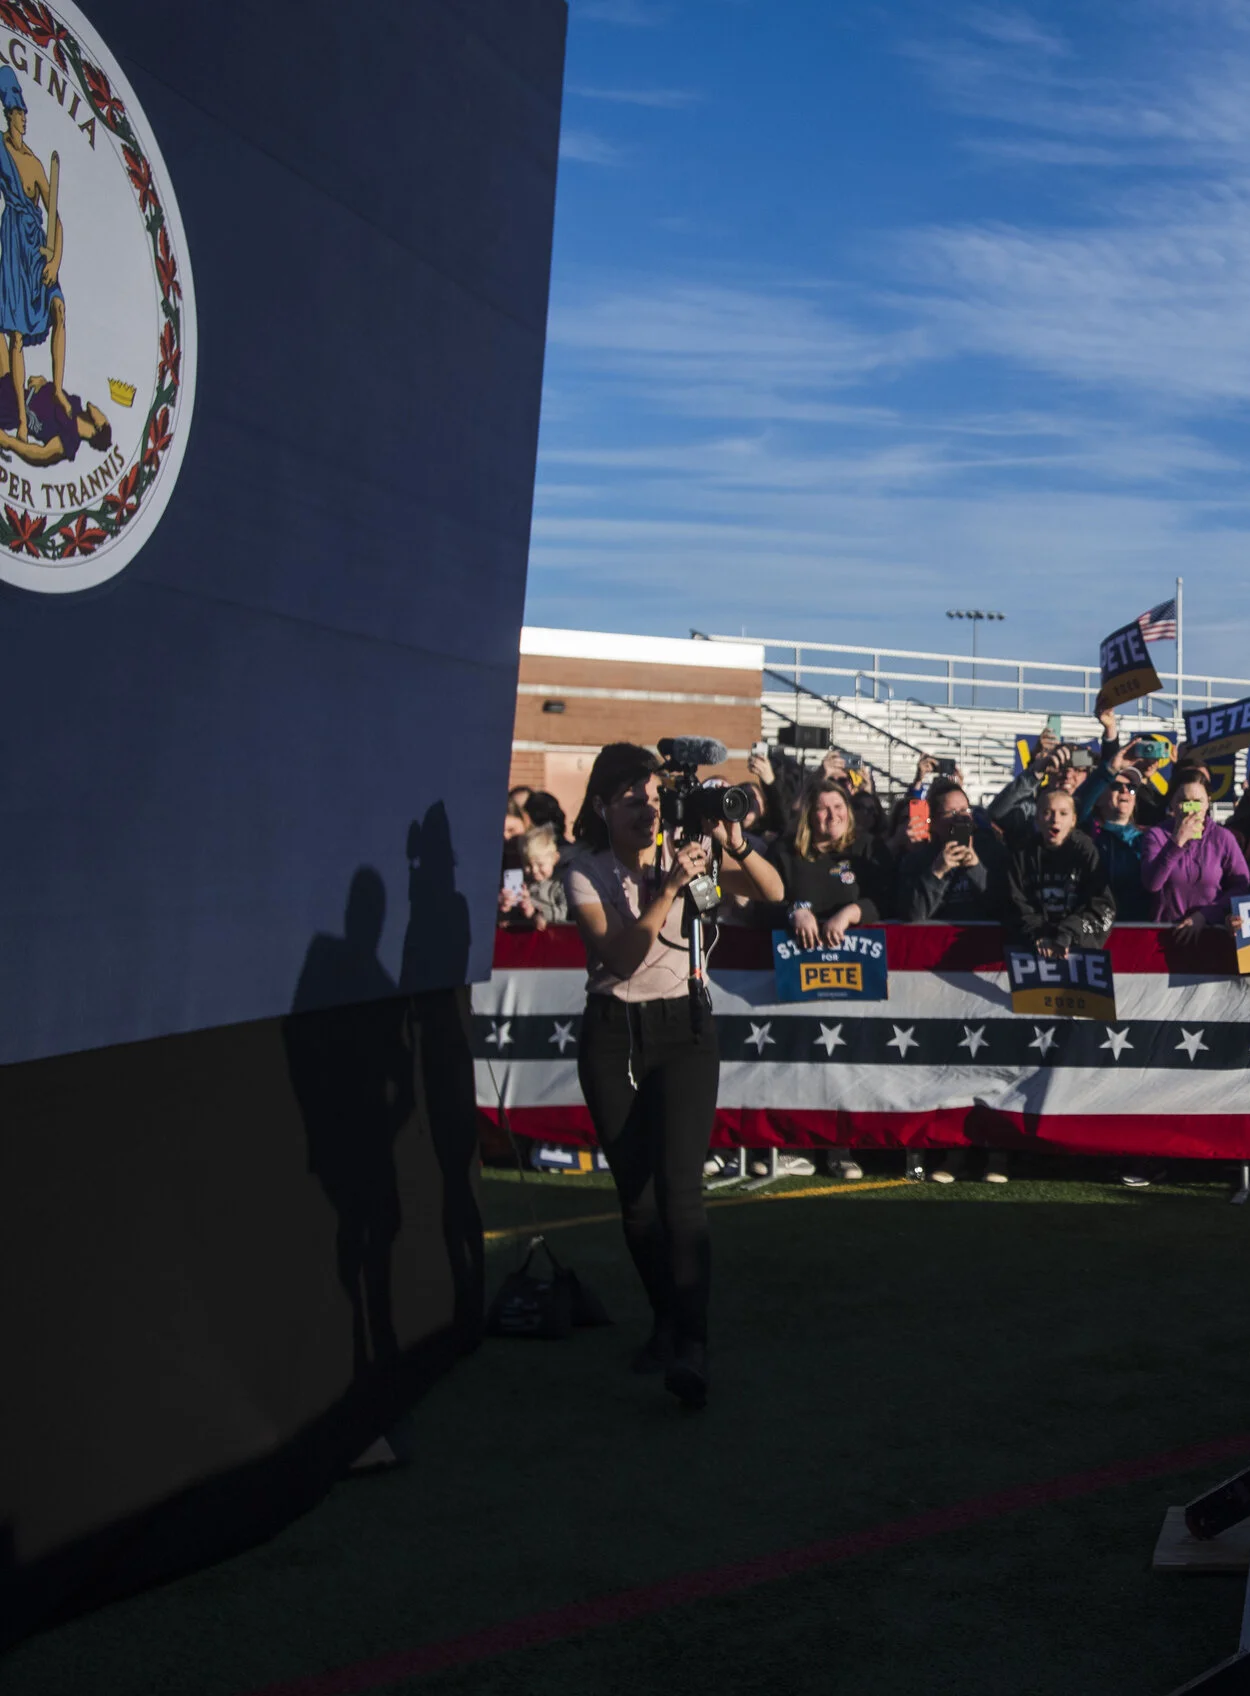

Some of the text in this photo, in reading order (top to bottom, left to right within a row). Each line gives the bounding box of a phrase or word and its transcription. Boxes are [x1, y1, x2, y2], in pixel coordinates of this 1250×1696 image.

[0, 38, 96, 151] GINIA
[41, 443, 125, 509] TYRANNIS
[1102, 627, 1146, 672] PETE
[804, 967, 858, 985] PETE
[821, 953, 839, 962] FOR
[1010, 951, 1107, 988] PETE
[1044, 996, 1085, 1009] 2020
